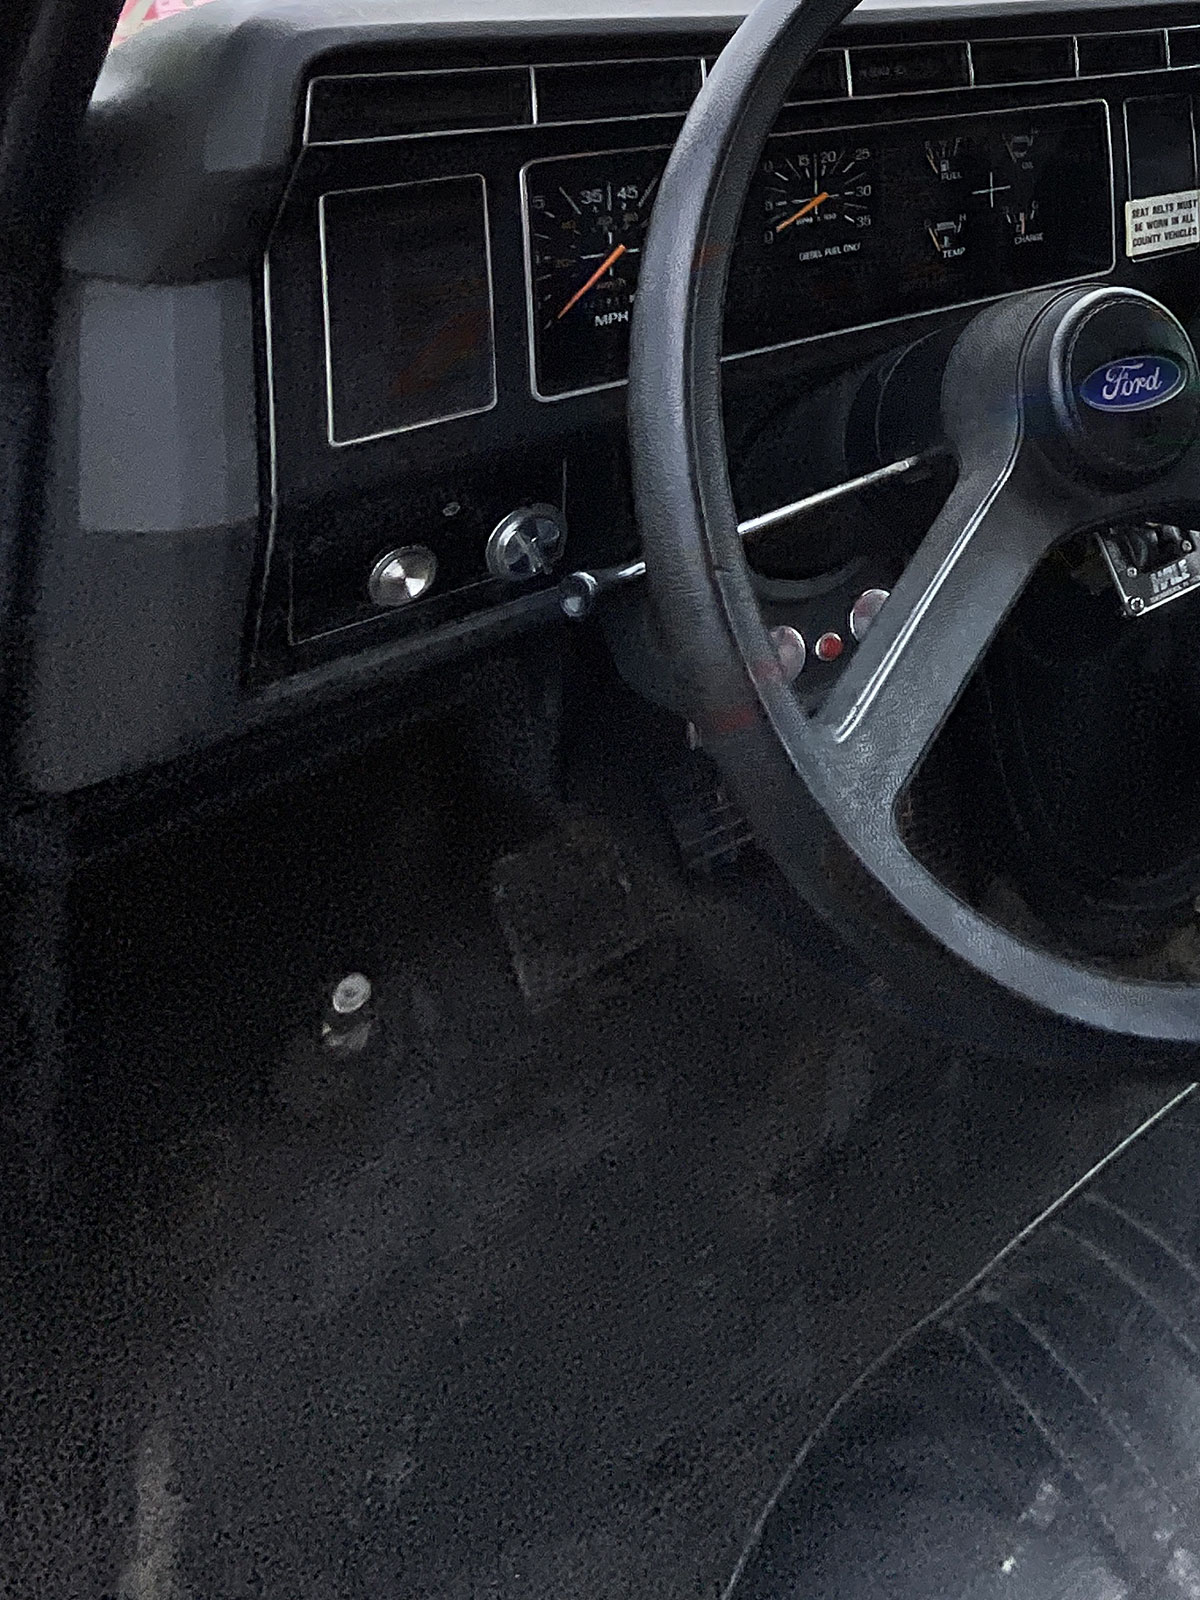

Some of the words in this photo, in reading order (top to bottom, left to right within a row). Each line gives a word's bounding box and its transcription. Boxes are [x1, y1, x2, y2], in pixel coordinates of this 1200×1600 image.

[821, 151, 837, 163] 20
[855, 148, 871, 160] 25
[941, 171, 962, 181] FUEL
[579, 188, 603, 204] 35
[617, 184, 639, 200] 45
[856, 185, 872, 198] 30
[1131, 207, 1149, 219] SEAT
[1152, 203, 1175, 215] BELTS
[1177, 198, 1198, 211] MUST
[855, 215, 871, 228] 35
[1134, 221, 1143, 233] BE
[1147, 218, 1168, 230] WORN
[1171, 216, 1180, 225] IN
[1181, 213, 1195, 224] ALL
[1132, 233, 1162, 248] COUNTY
[1164, 226, 1198, 241] VEHICLES
[824, 245, 842, 257] FUEL
[942, 246, 967, 259] TEMP
[594, 310, 630, 328] MPH
[1102, 362, 1163, 401] Ford
